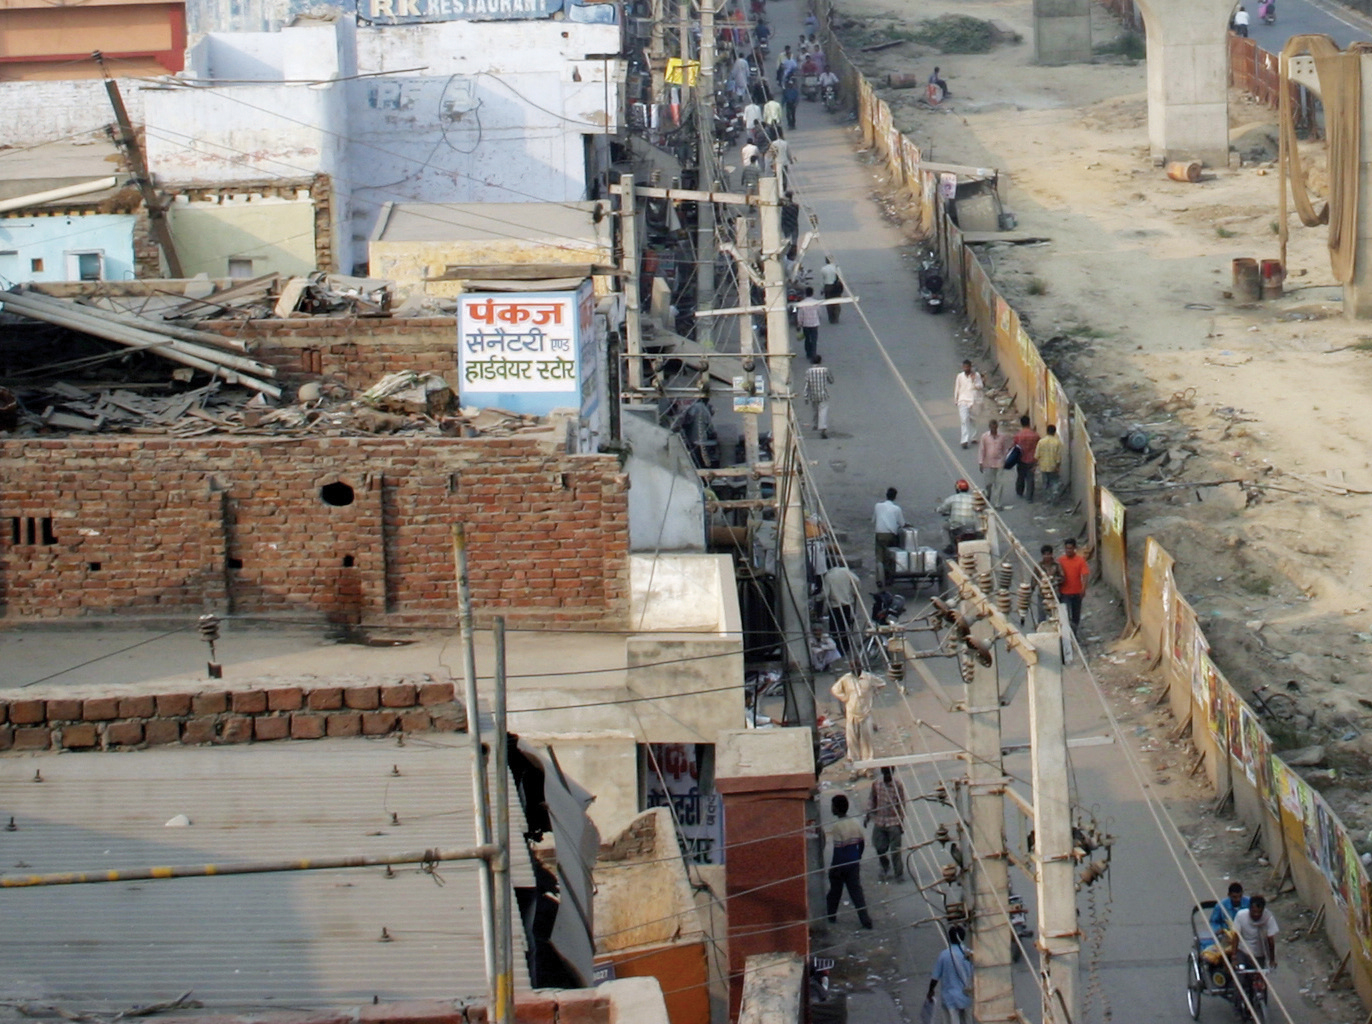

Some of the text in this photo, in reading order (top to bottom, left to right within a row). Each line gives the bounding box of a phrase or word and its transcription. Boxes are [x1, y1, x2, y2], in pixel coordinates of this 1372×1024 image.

[466, 298, 565, 325] पंकज
[551, 338, 570, 351] एण्ड
[465, 355, 575, 383] हार्डवेयर स्टोर
